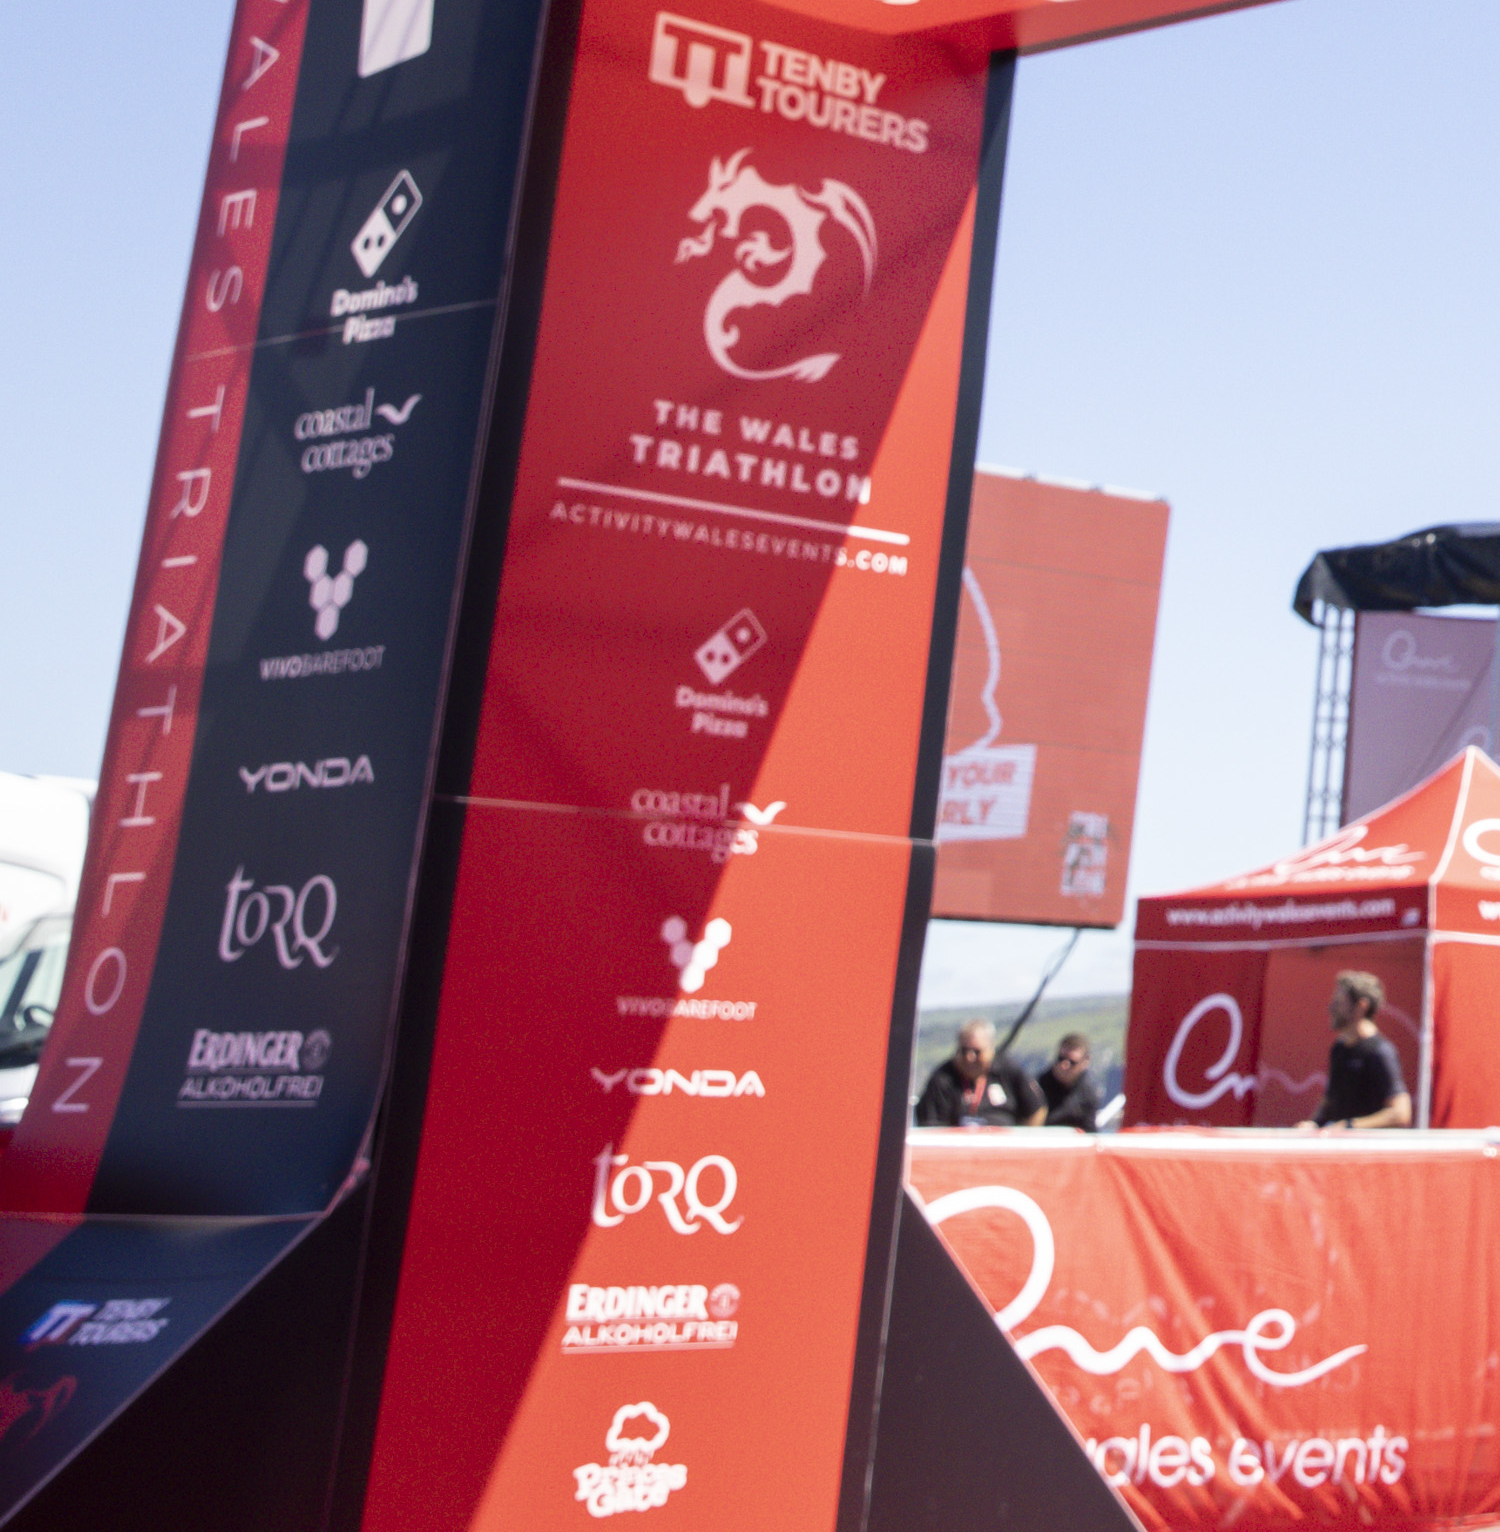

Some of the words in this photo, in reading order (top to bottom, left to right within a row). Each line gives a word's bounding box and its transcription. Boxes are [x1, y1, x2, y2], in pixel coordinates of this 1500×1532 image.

[760, 41, 887, 105] TENBY
[754, 82, 929, 153] TOURERS
[343, 314, 396, 345] Pizza
[295, 388, 376, 440] coastal
[653, 399, 723, 435] THE
[739, 416, 860, 461] WALES
[300, 435, 394, 478] cottages
[630, 434, 872, 506] TRIATHLON
[549, 500, 908, 575] ACTIVITYWALESEVENTS.COM
[260, 645, 387, 680] VIVOBAREFOOT
[51, 385, 227, 1114] TRIATHLON
[239, 755, 375, 794] YONDA
[186, 1028, 303, 1073] ERDINGER
[177, 1074, 325, 1101] ALKOHOLFREI
[590, 1067, 766, 1099] YONDA
[566, 1282, 709, 1322] ERDINGER
[560, 1320, 739, 1347] ALKOHOLFREI
[1085, 1422, 1216, 1488] ales
[1228, 1424, 1408, 1488] events
